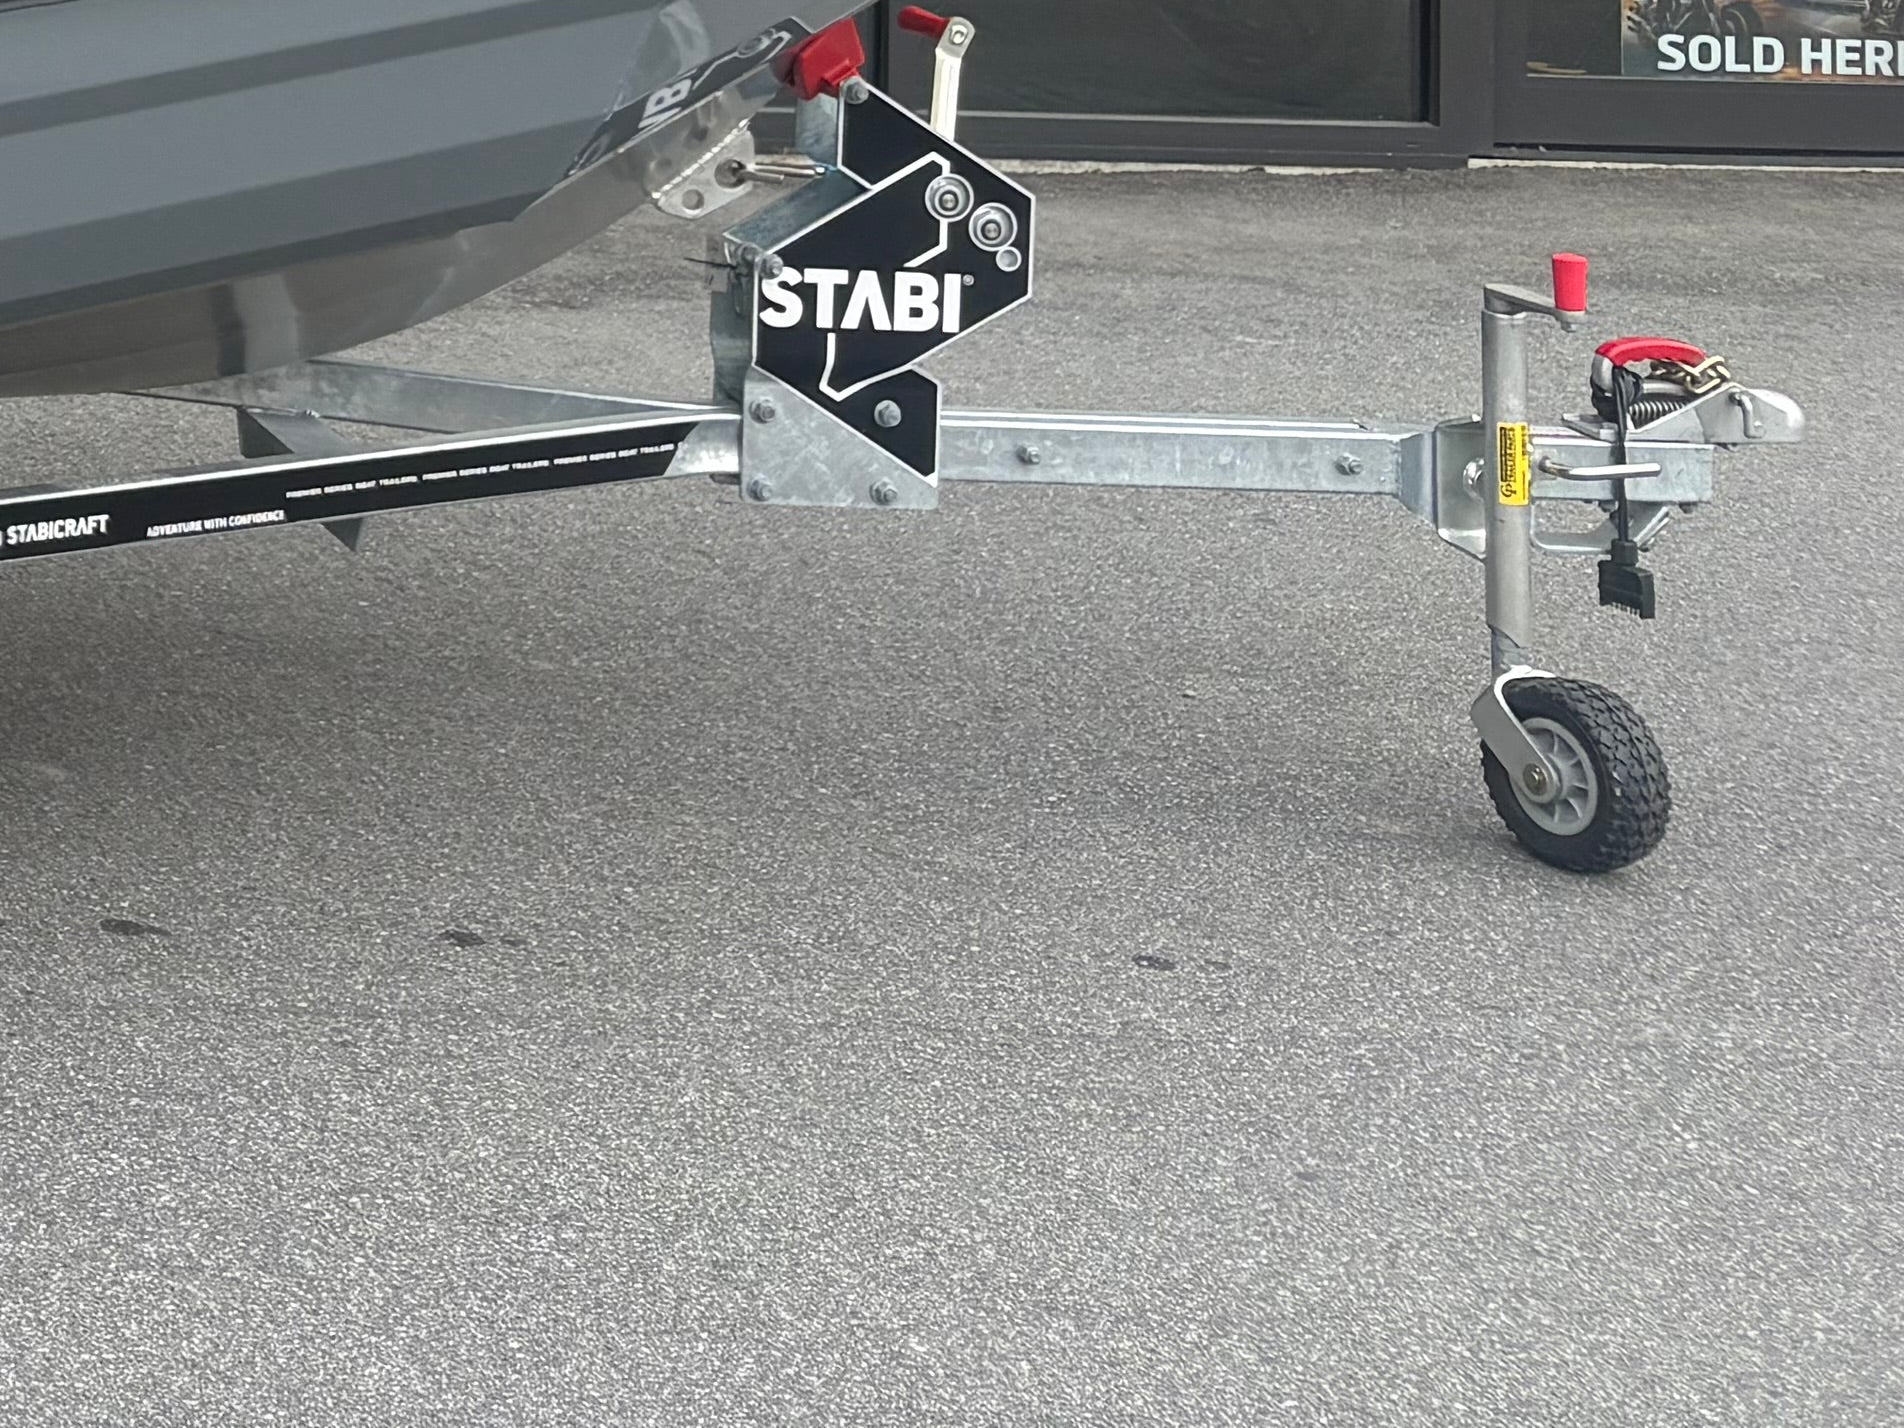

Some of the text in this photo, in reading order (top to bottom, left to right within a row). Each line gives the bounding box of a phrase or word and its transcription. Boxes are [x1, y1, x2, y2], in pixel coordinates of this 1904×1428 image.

[1656, 33, 1904, 77] SOLD HER
[759, 265, 962, 334] STABI
[6, 514, 110, 545] STABICRAFT
[146, 509, 286, 538] ADVENTURE WITH CONFIDENCE
